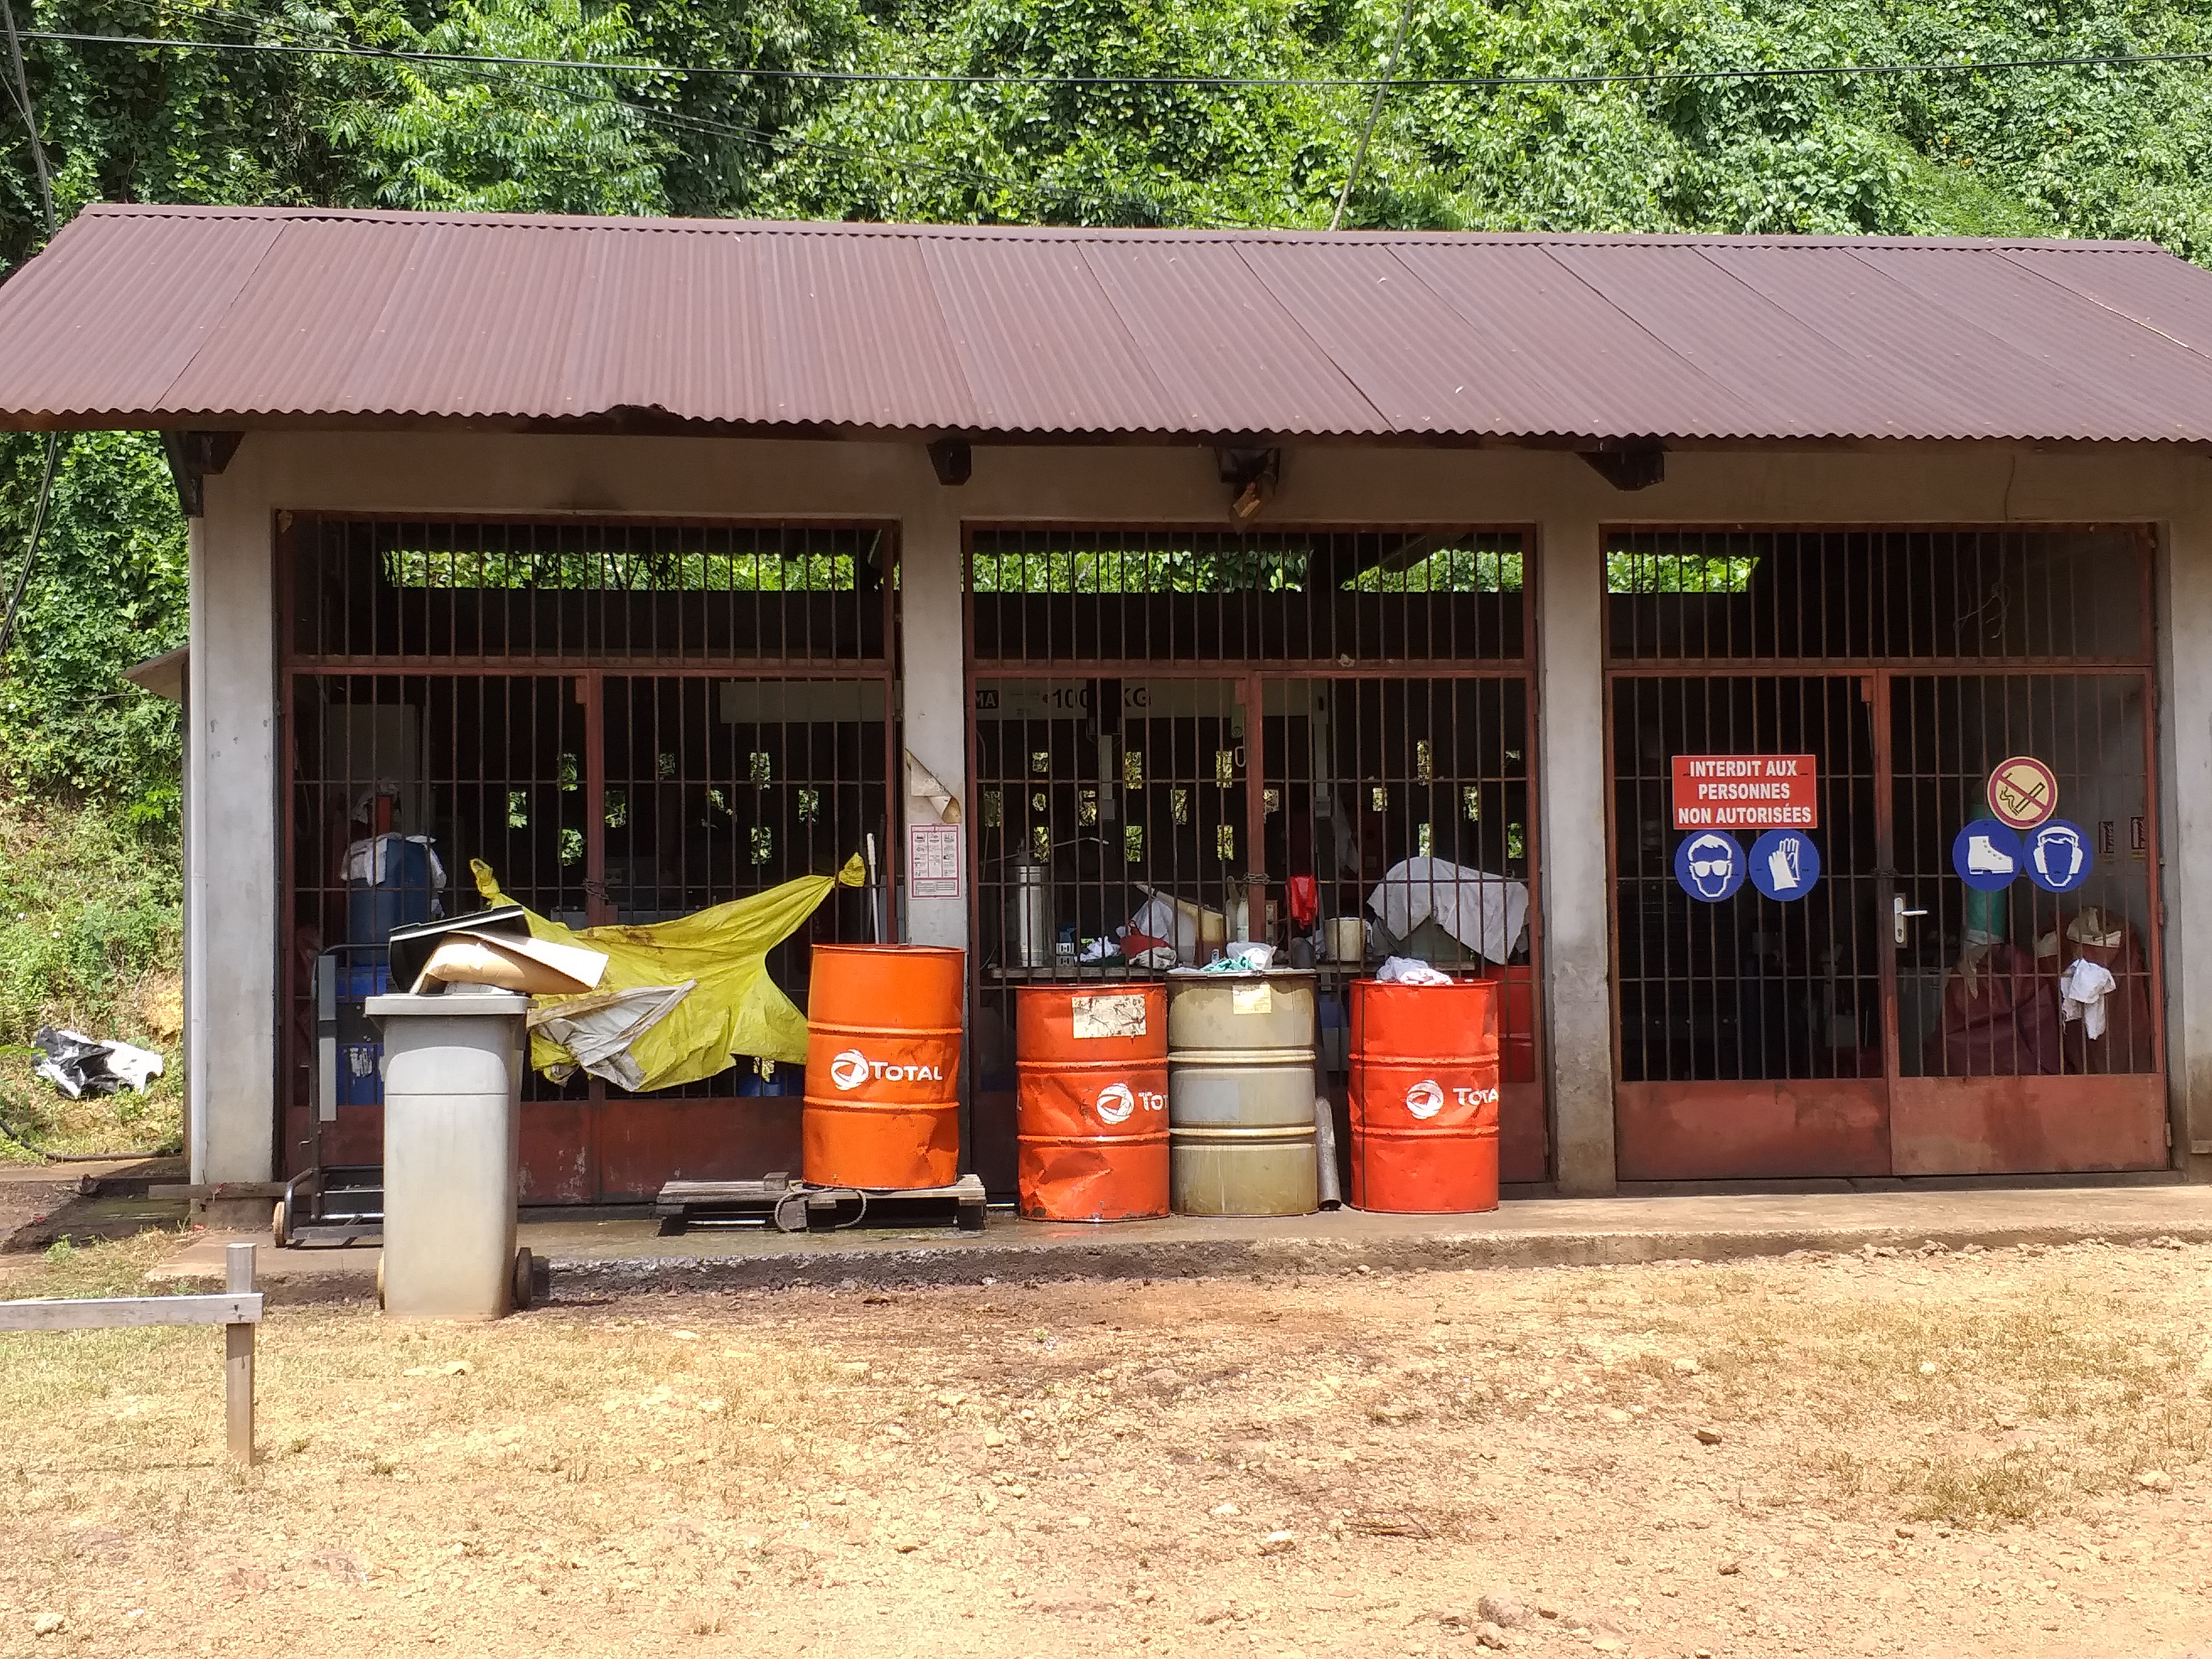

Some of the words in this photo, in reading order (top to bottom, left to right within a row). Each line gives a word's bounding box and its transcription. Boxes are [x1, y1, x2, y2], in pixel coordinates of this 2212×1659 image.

[1689, 760, 1761, 777] INTERDIT
[1765, 760, 1798, 777] AUX
[1698, 782, 1791, 800] PERSONNES
[1678, 807, 1711, 824] NON
[1715, 803, 1812, 824] AUTORISÉES
[869, 1061, 943, 1081] TOTAL
